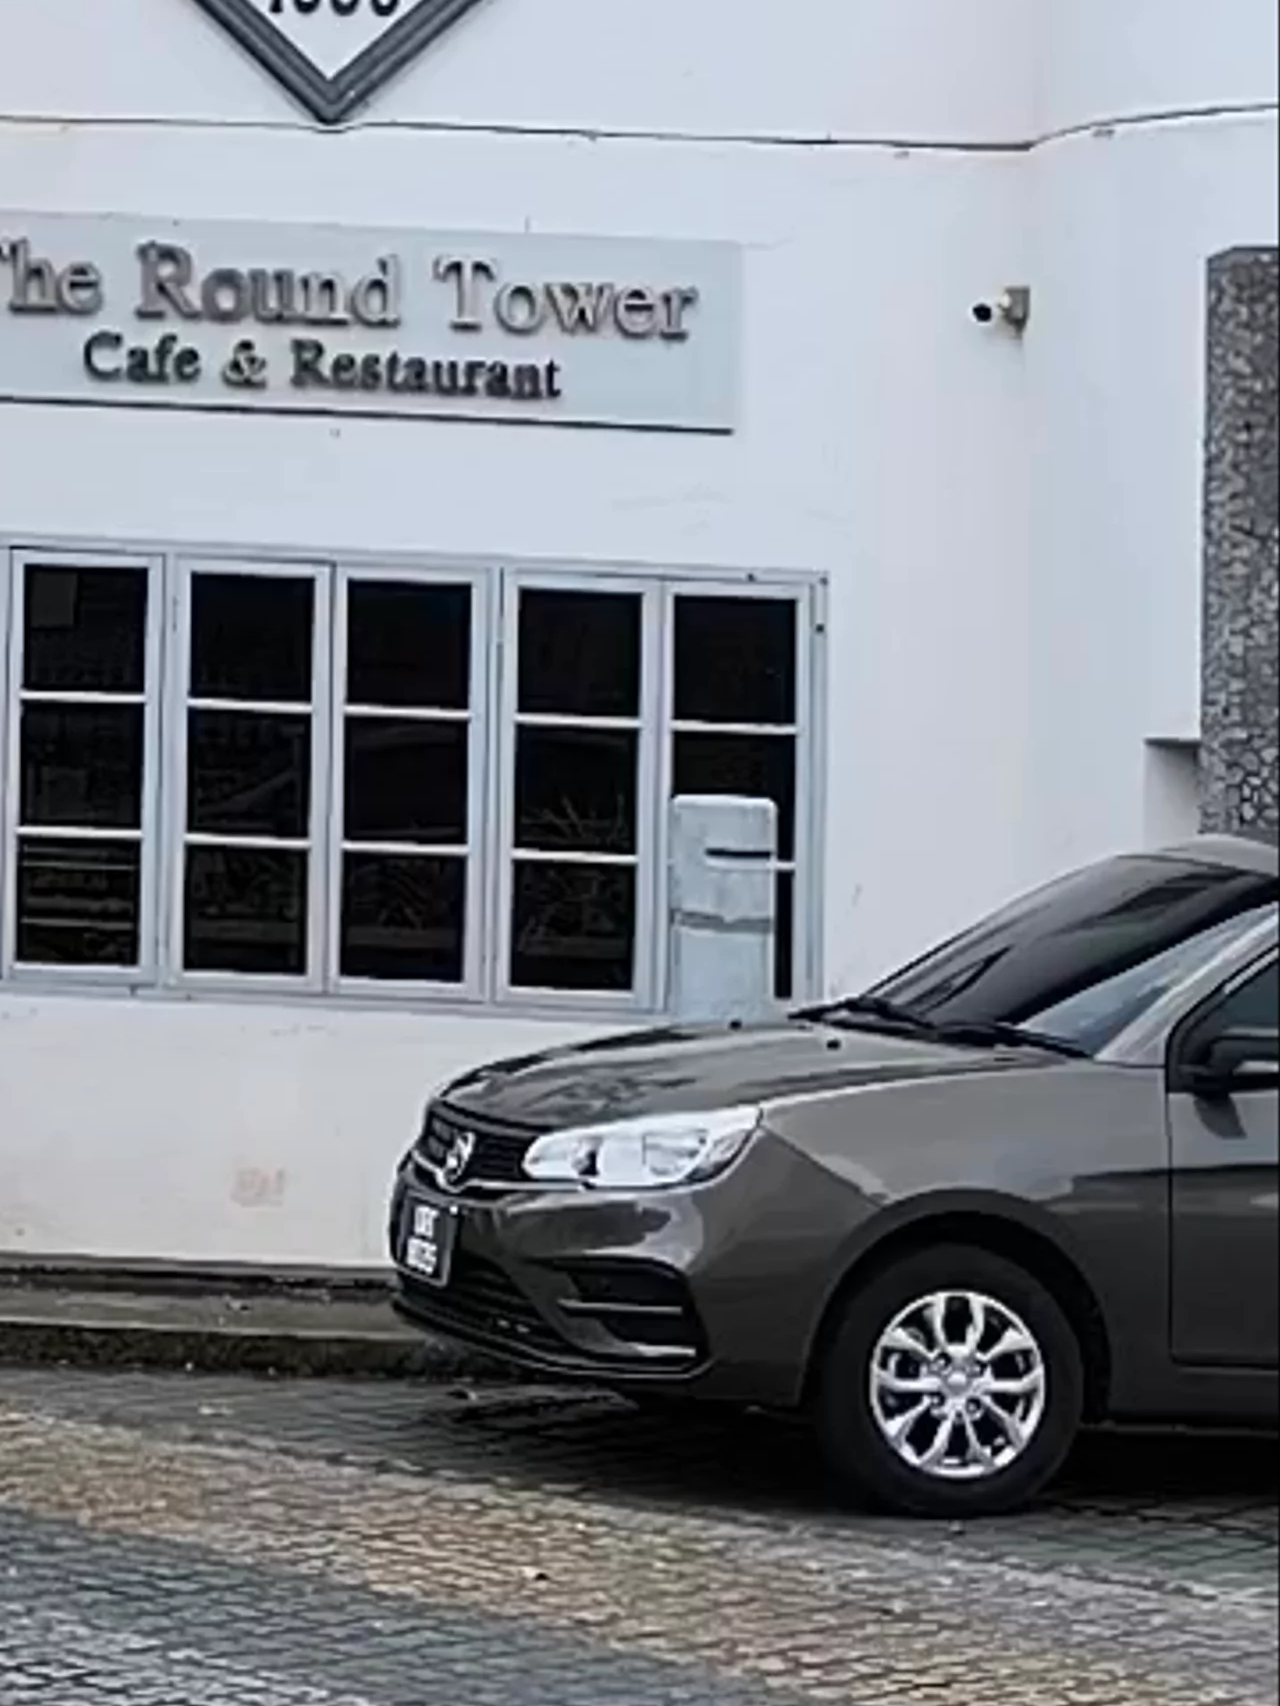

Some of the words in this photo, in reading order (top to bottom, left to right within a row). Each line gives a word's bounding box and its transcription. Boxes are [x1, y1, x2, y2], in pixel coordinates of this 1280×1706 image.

[134, 239, 401, 329] Round
[432, 254, 699, 342] Tower
[81, 329, 202, 386] Cafe
[220, 338, 269, 390] &
[289, 336, 563, 401] Restaurant
